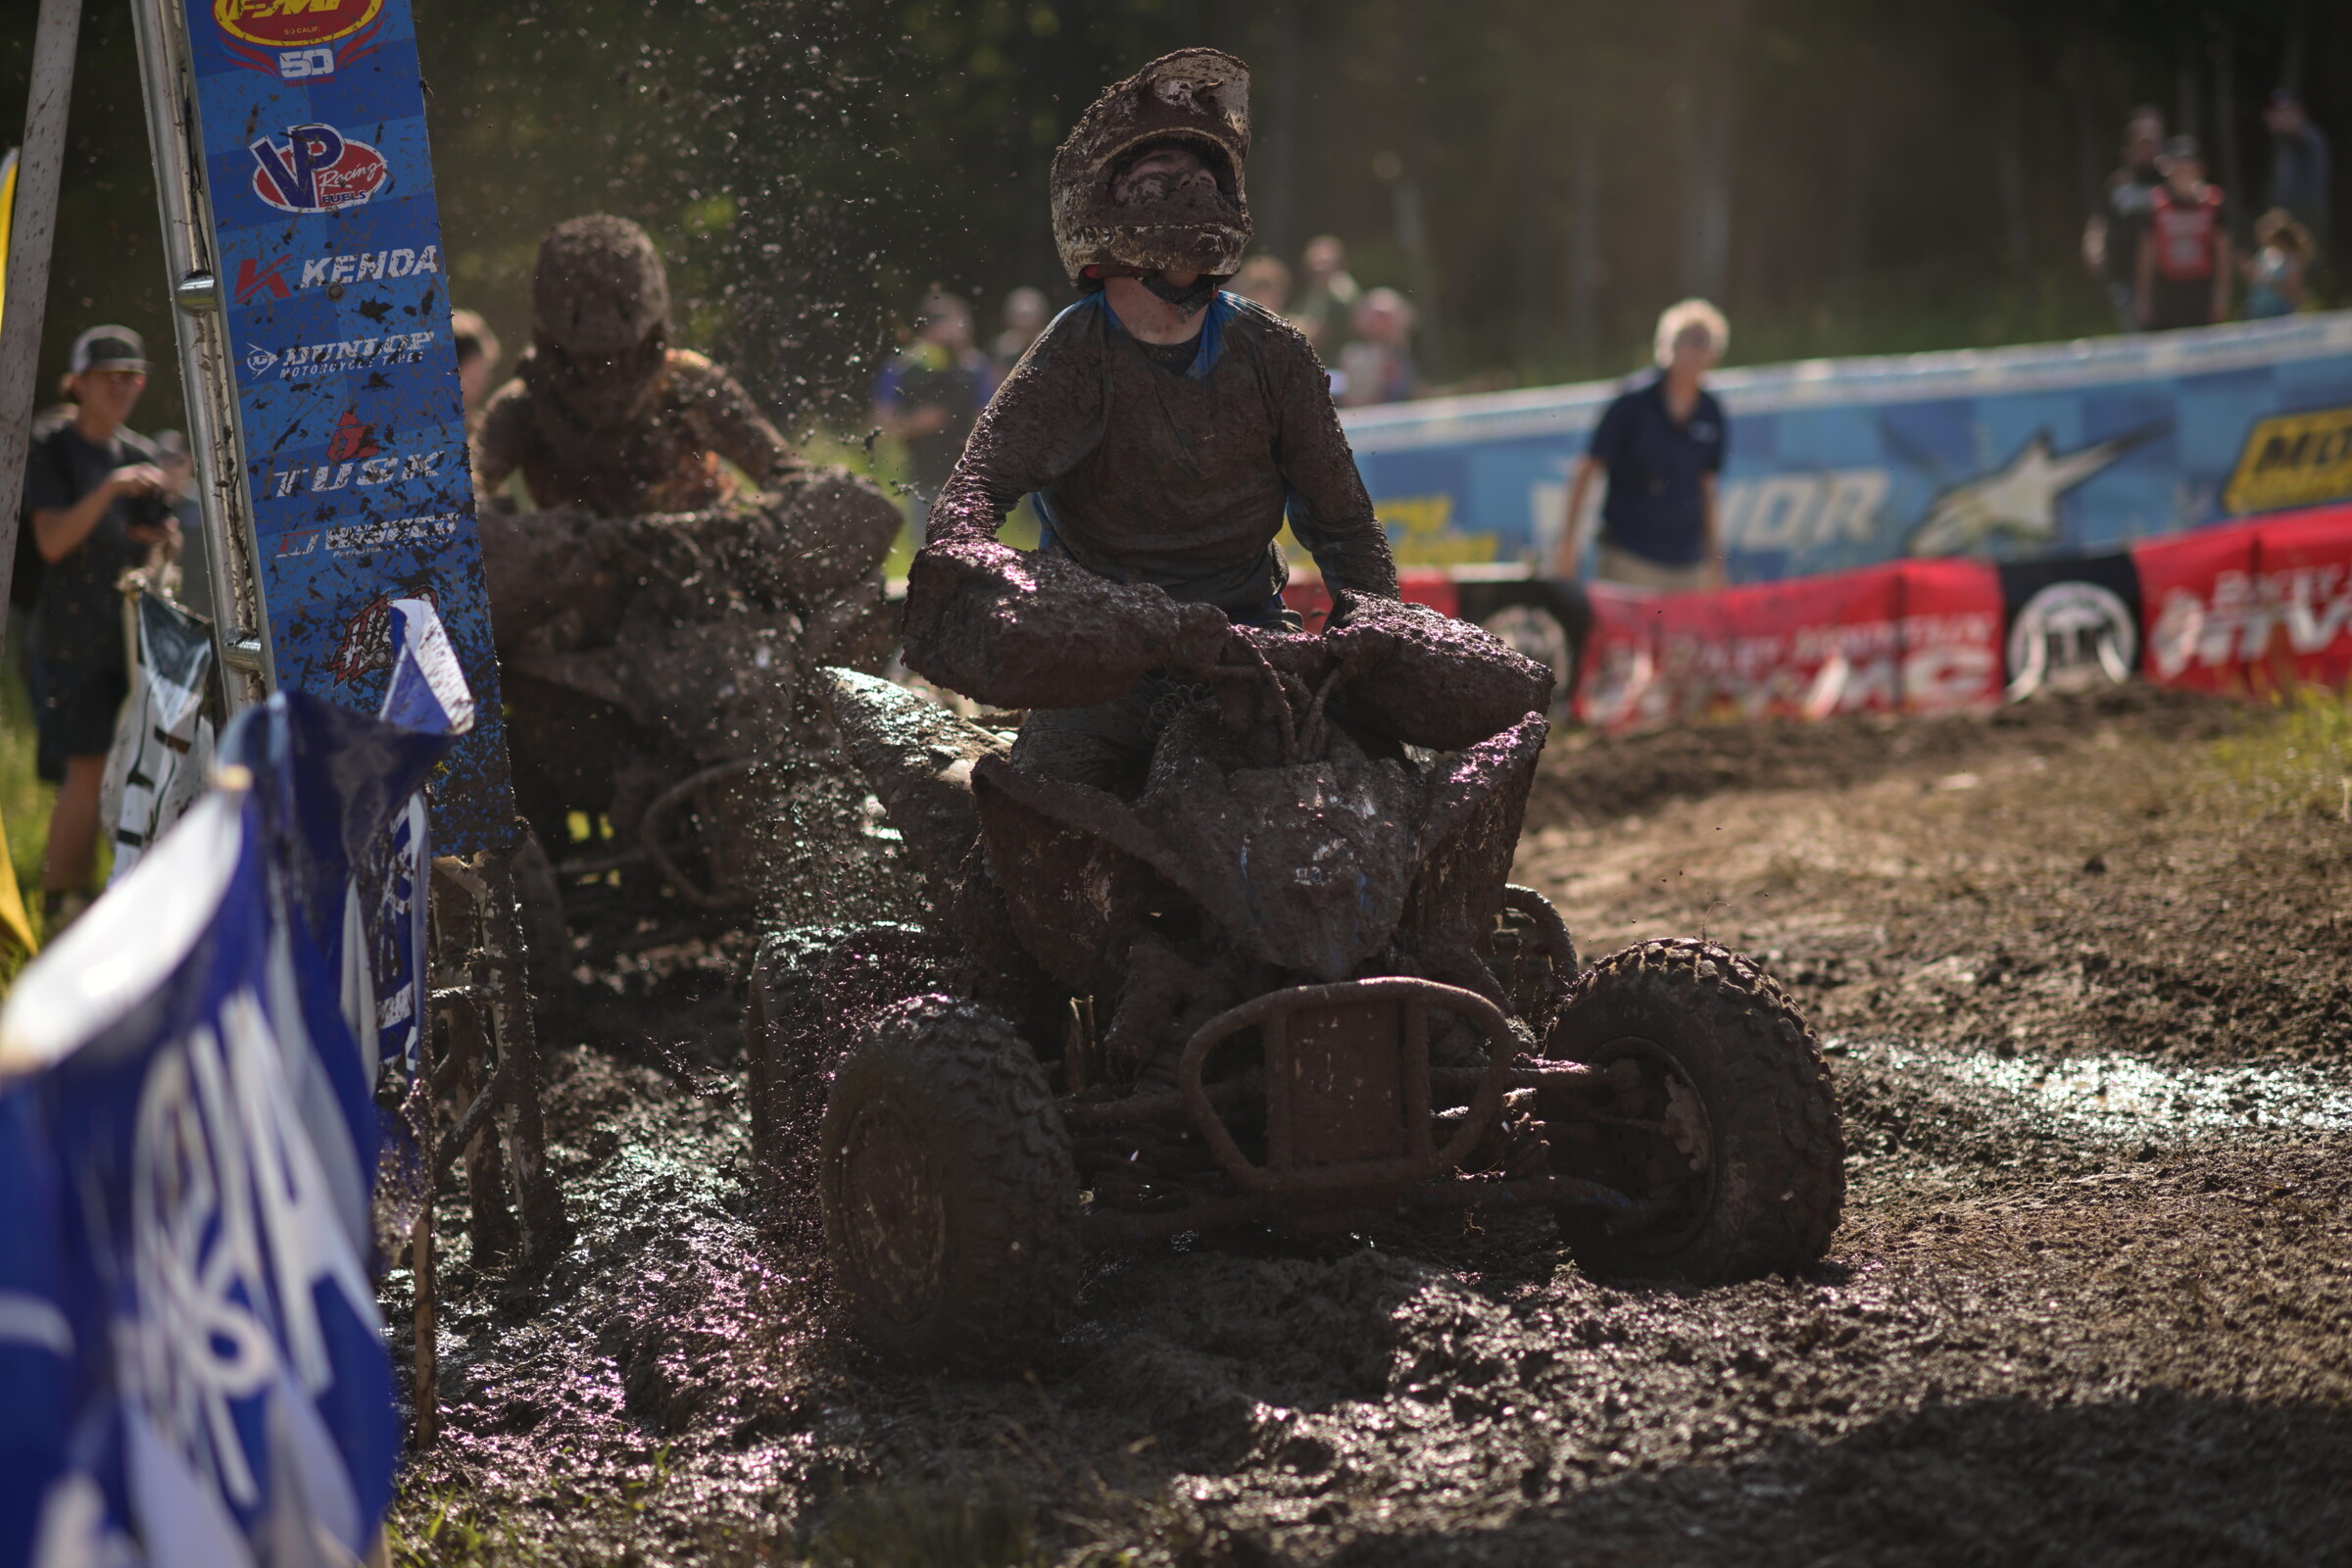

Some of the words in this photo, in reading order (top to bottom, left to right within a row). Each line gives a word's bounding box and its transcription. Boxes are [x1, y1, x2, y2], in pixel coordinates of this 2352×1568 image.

[296, 25, 320, 34] CALIF.
[279, 48, 335, 78] 50
[249, 122, 345, 209] VP
[318, 159, 389, 194] Racing
[321, 190, 367, 204] FUELS
[300, 244, 439, 289] KENDA
[281, 330, 435, 367] DUNLOP
[272, 450, 446, 498] TUSK
